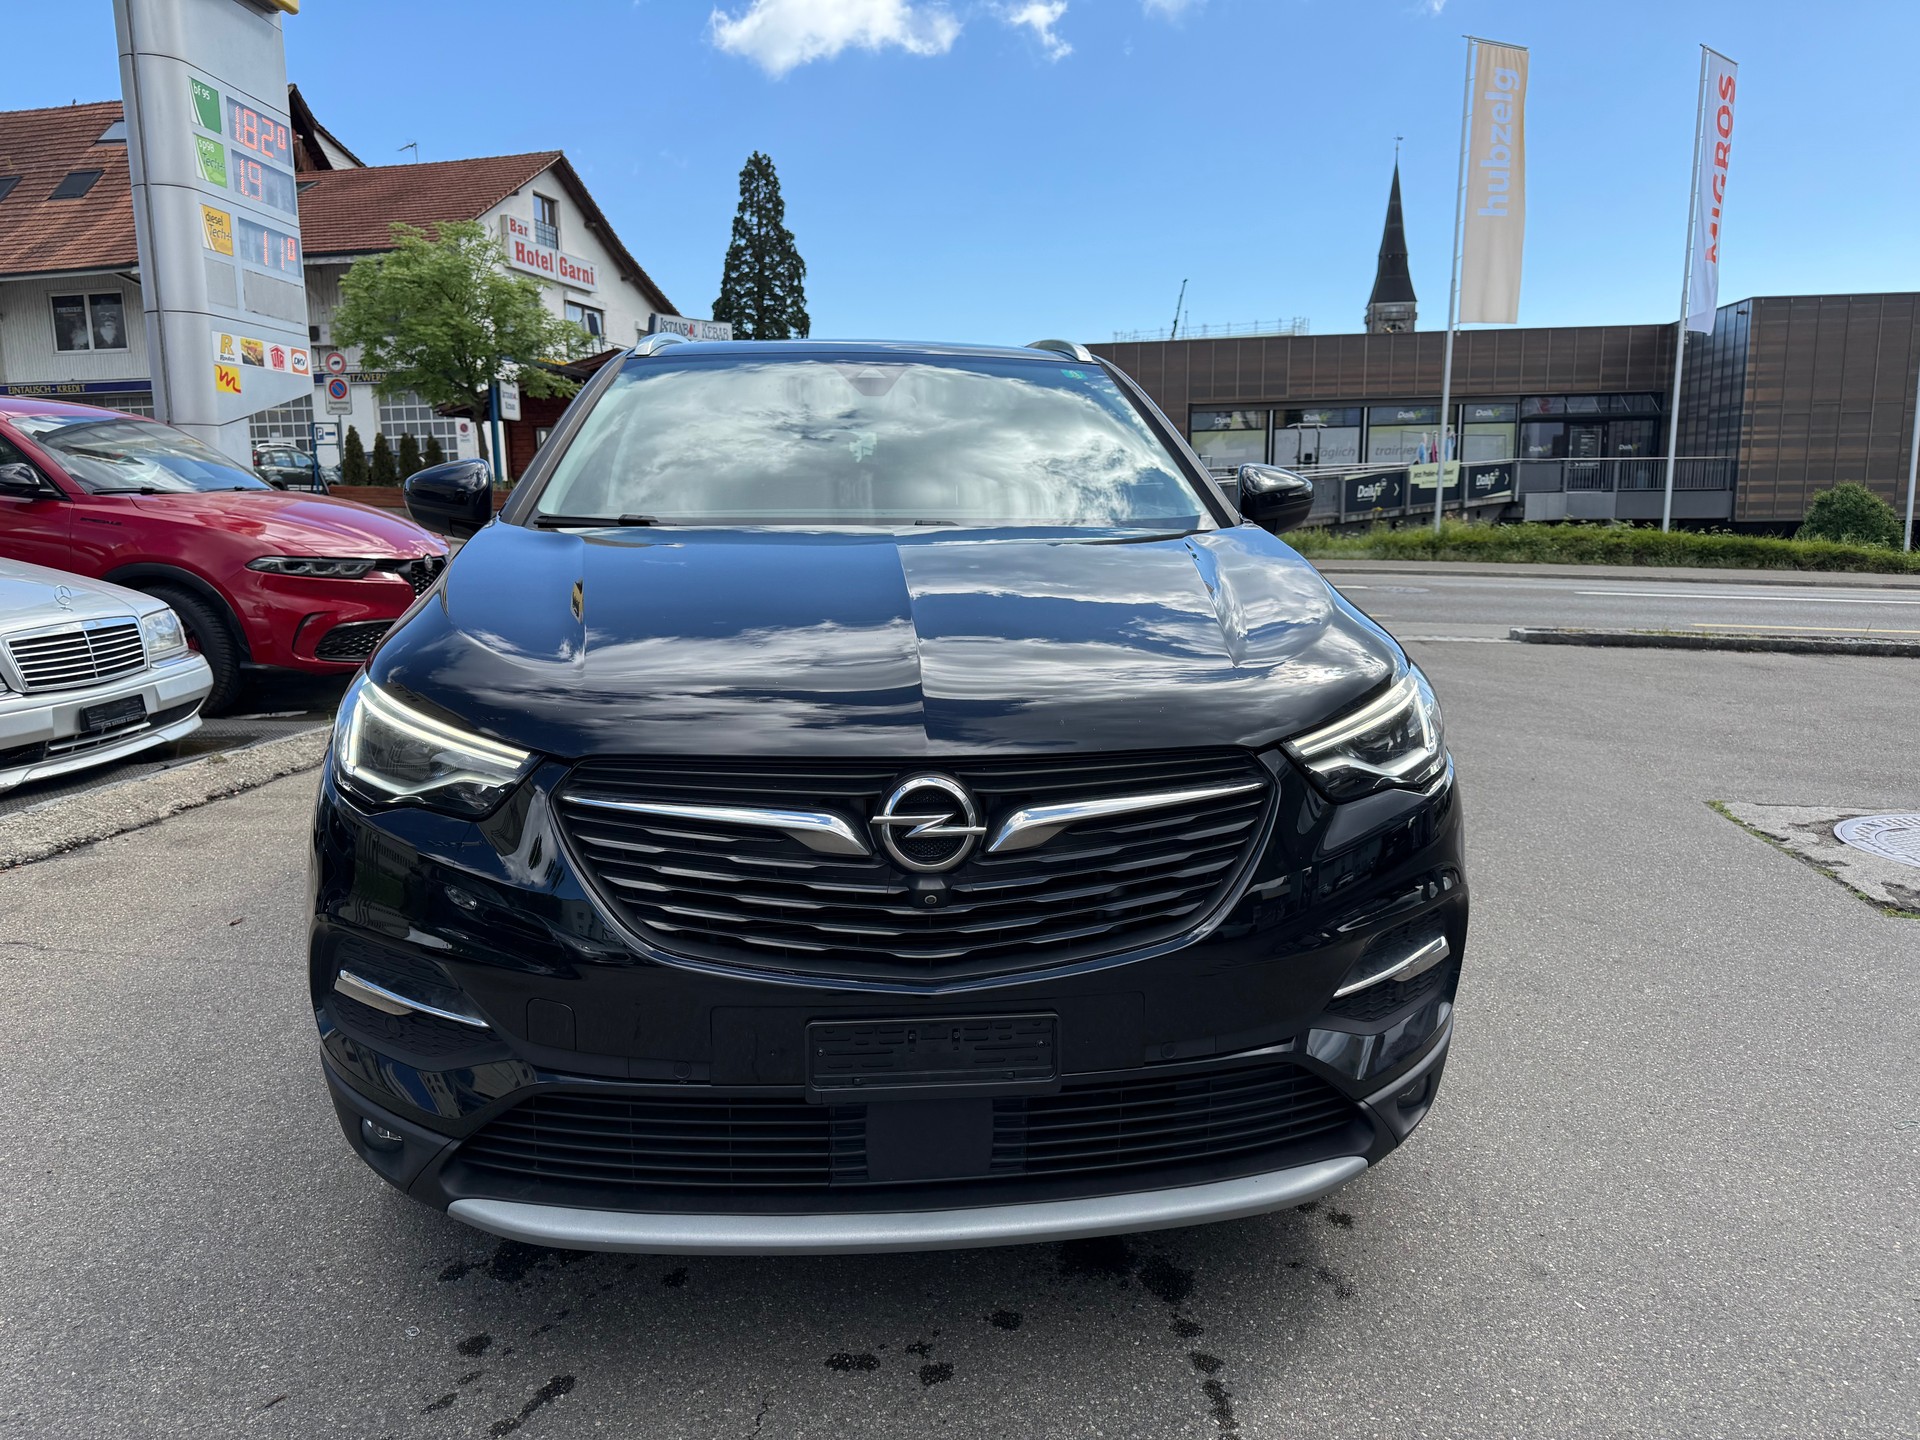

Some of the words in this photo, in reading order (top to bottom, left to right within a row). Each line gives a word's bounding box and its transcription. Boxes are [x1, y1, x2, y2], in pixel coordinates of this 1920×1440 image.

[1477, 67, 1520, 216] hubzelg
[1704, 72, 1736, 265] MIGROS
[205, 211, 224, 227] diesel
[509, 217, 529, 237] Bar
[515, 240, 554, 273] Hotel
[559, 256, 595, 286] Garni
